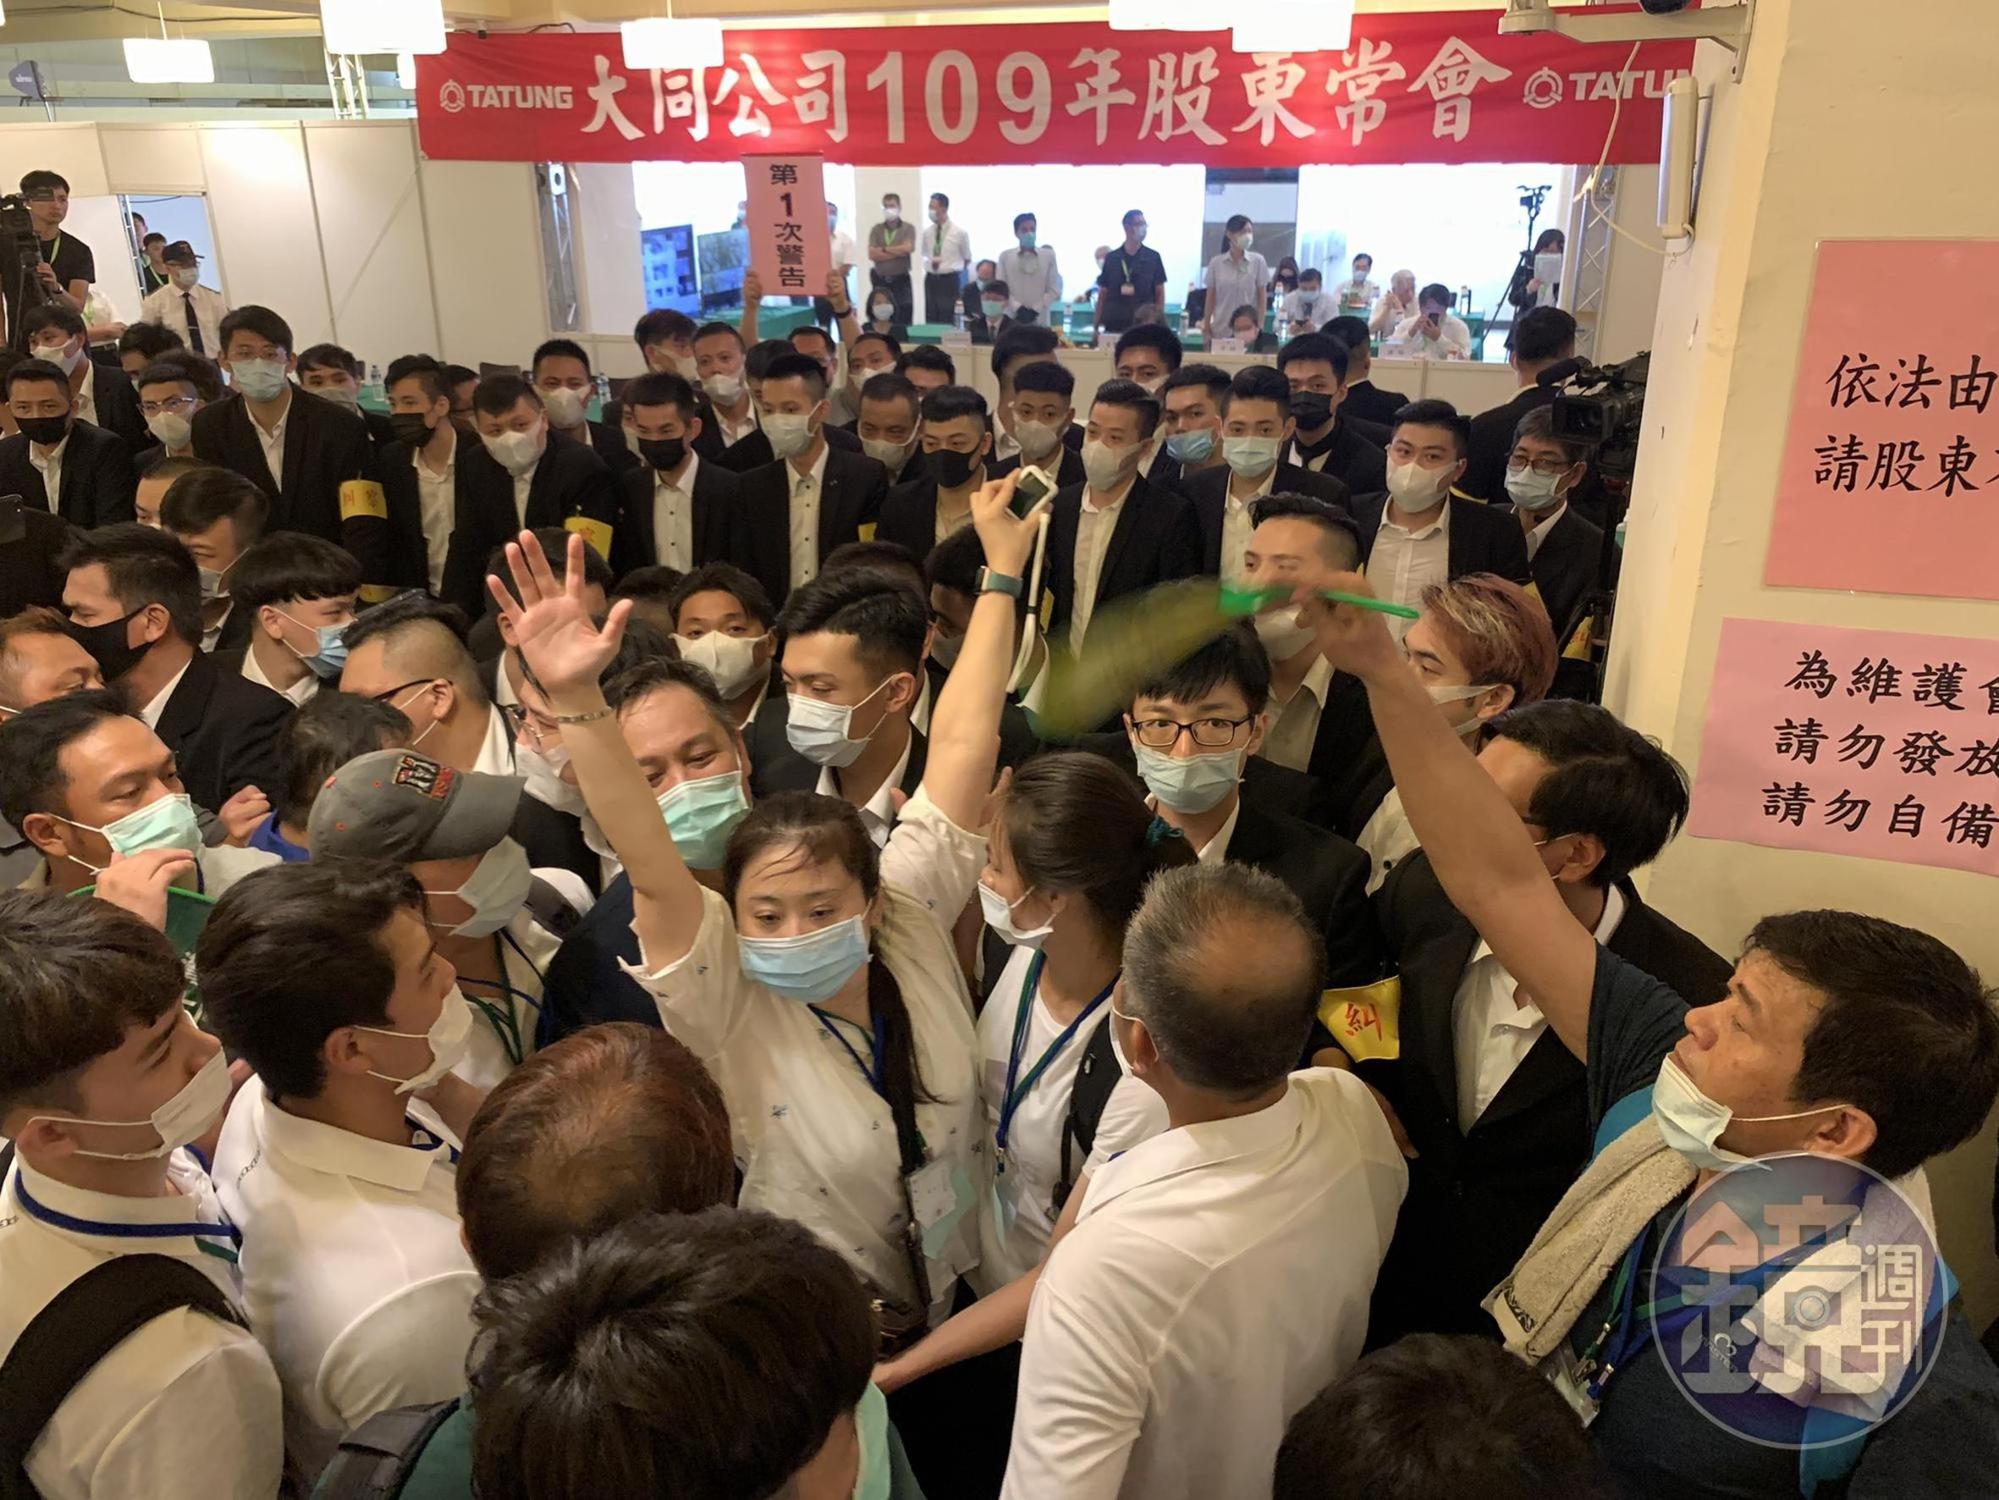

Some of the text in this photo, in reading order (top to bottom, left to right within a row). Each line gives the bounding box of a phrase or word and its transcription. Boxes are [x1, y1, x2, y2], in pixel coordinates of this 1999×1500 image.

[467, 85, 574, 110] TATUNG
[580, 36, 1513, 146] 大同公司109年股東常會
[769, 163, 806, 288] 第1次警告
[1825, 352, 1999, 414] 依法由
[1813, 433, 1999, 498] 請股東
[1761, 781, 1999, 849] 請勿自備
